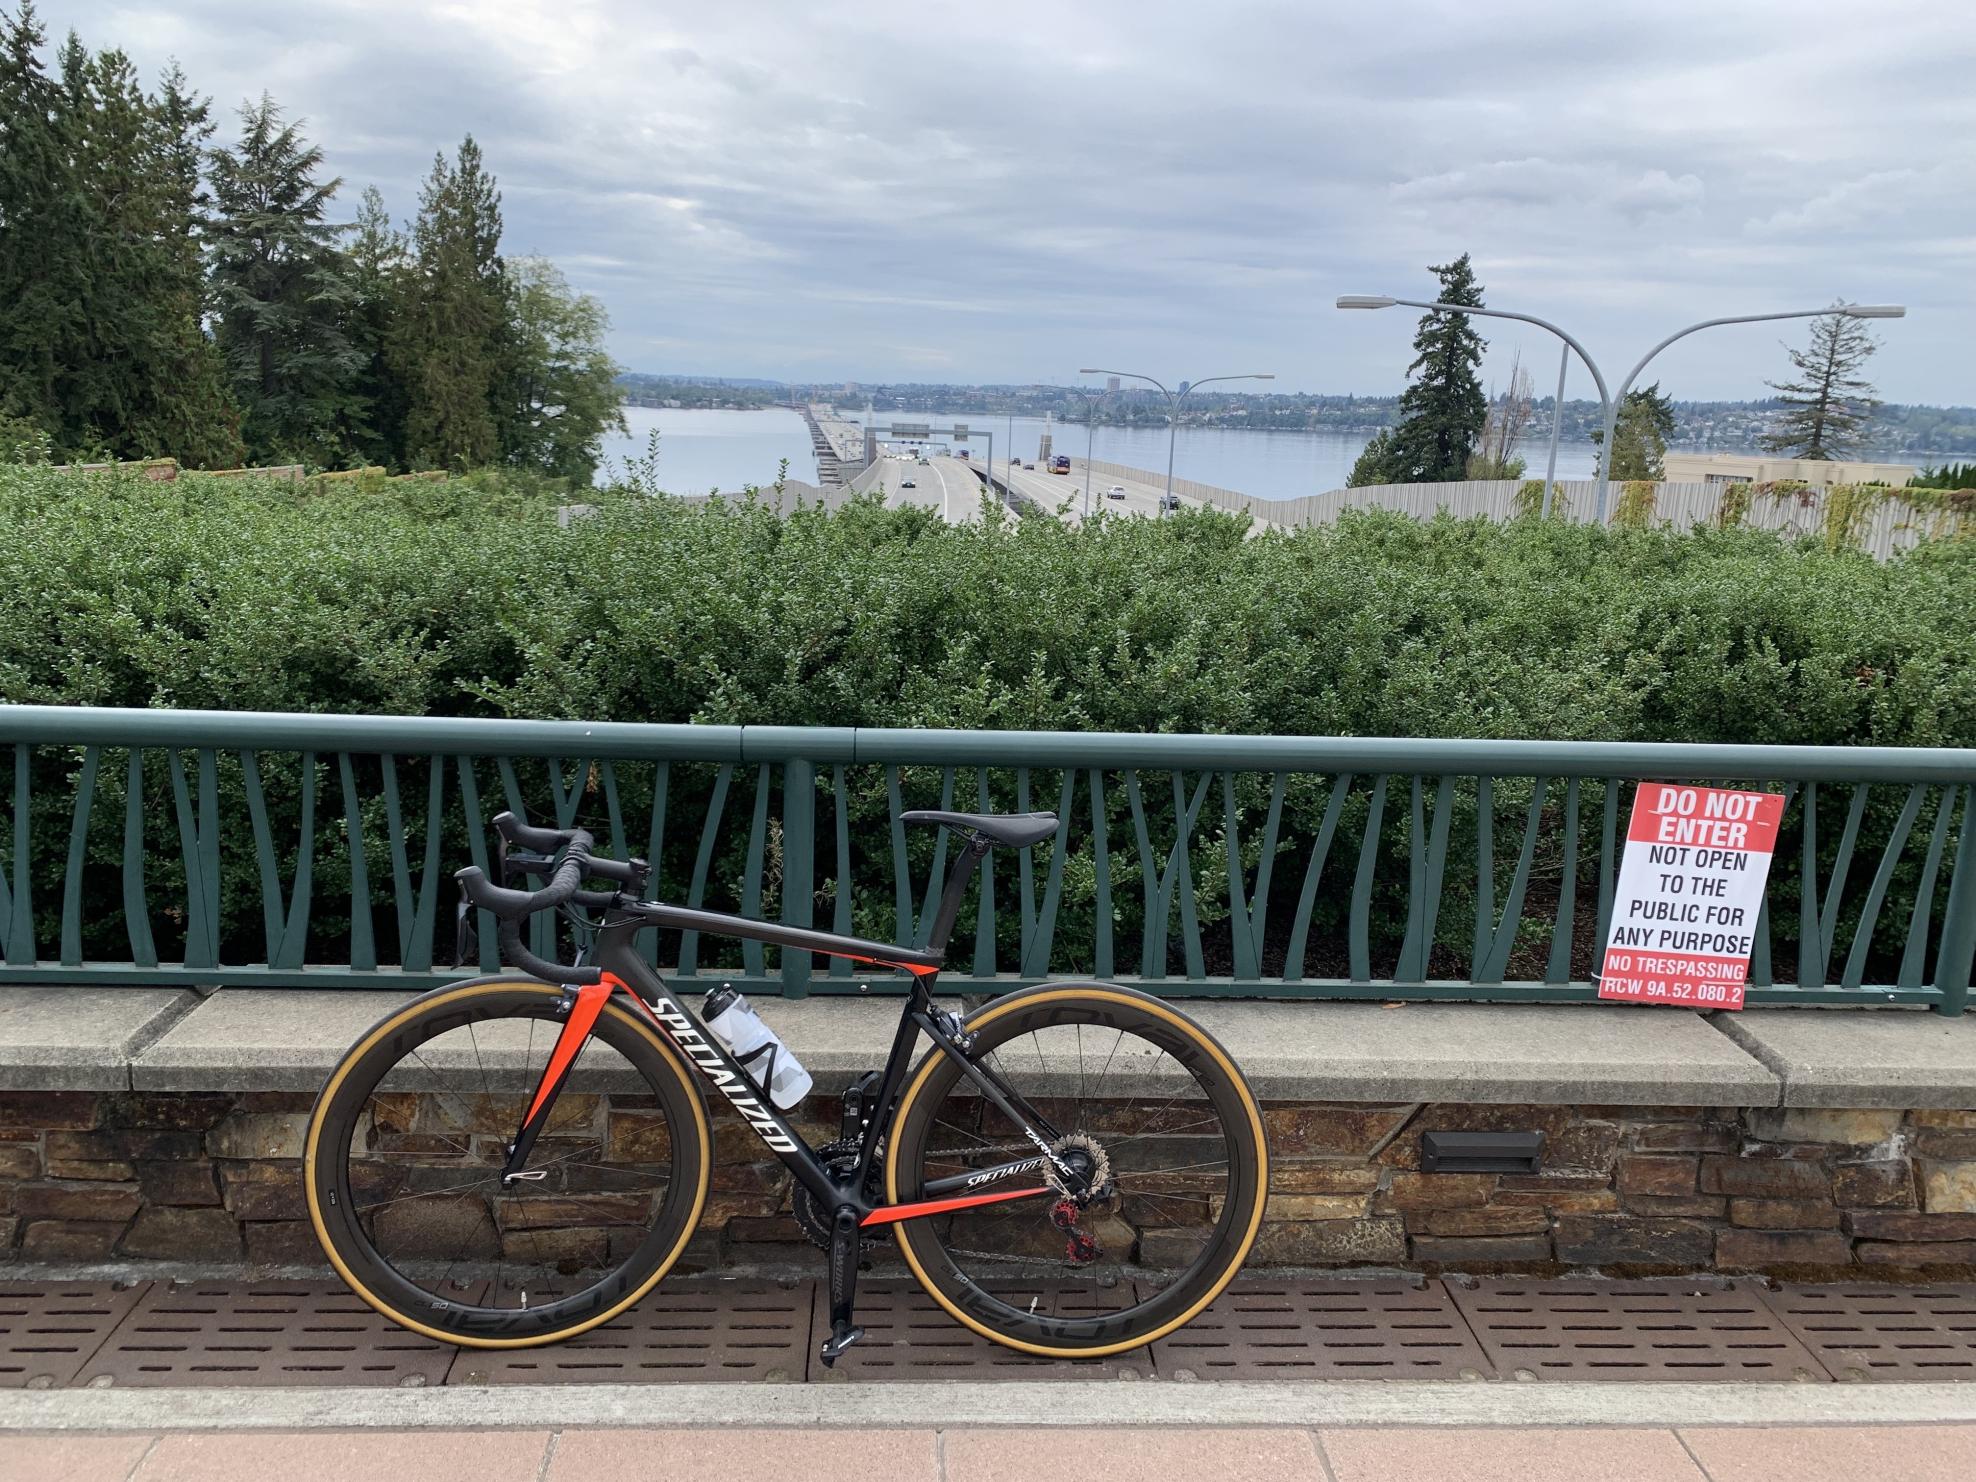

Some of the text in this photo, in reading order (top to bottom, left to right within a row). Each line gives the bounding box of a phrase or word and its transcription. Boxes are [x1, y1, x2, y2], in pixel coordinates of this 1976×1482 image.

[1657, 788, 1762, 821] DO NOT
[1657, 816, 1748, 848] ENTER
[1649, 845, 1748, 871] NOT OPEN
[1660, 874, 1728, 897] TO THE
[1629, 899, 1744, 927] PUBLIC FOR
[1612, 926, 1751, 955] ANY PURPOSE
[1608, 955, 1744, 981] NO TRESPASSING
[1605, 979, 1742, 1003] RCW 9A.52.080.2
[642, 998, 798, 1152] SPECIALIZED
[1025, 1126, 1074, 1177] TARMAC
